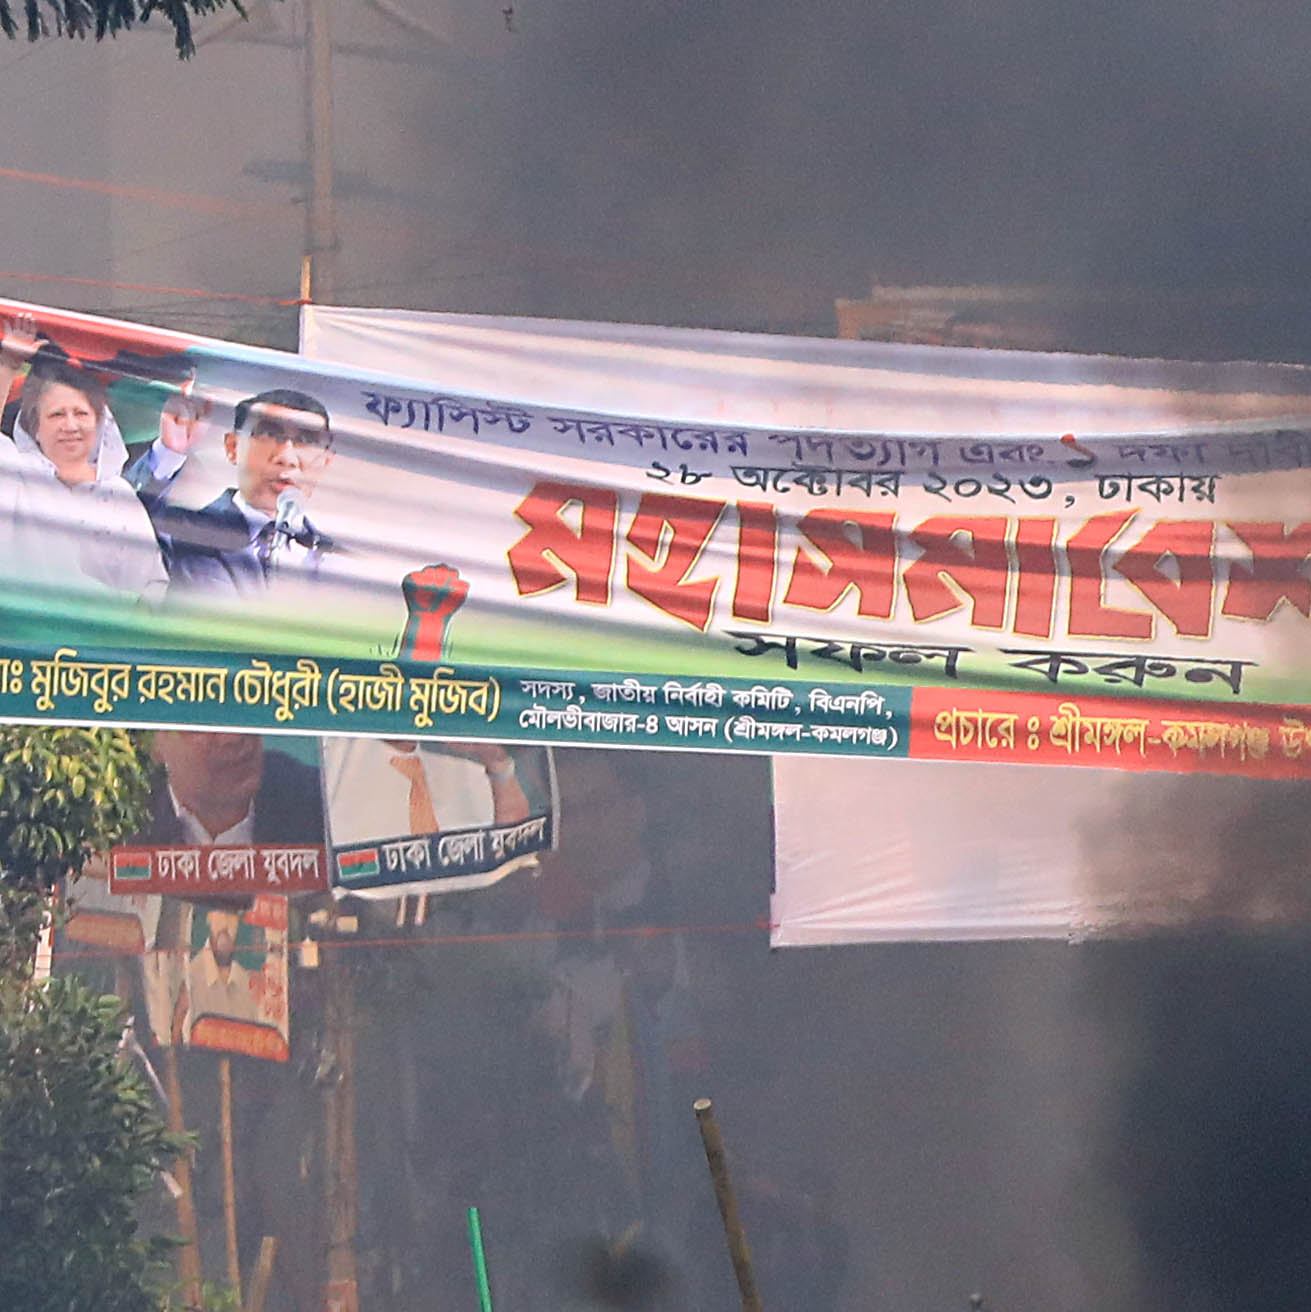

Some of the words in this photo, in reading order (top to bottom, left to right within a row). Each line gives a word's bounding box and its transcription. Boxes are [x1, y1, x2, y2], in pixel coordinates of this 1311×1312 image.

[362, 391, 533, 436] ফ্যাসিস্ট
[547, 416, 750, 457] সরকারের
[769, 433, 940, 469] পদত্যাগ
[646, 460, 711, 487] ২৮
[731, 463, 903, 499] অক্টোবর
[1097, 472, 1222, 504] ঢাকায়
[721, 630, 977, 680] সফল
[998, 647, 1259, 695] করুন
[30, 648, 131, 712] মুজিবুর
[136, 664, 228, 706] রহমান
[232, 658, 322, 720] চৌধুরী
[326, 663, 405, 716] (হাজী
[408, 667, 500, 729] মুজিব)
[592, 681, 656, 705] জাতীয়
[663, 680, 726, 708] নির্বাহী
[665, 715, 719, 738] আসন
[157, 849, 200, 880] ঢাকা
[207, 848, 257, 880] জেলা
[261, 848, 320, 884] যুবদল
[384, 838, 431, 872] ঢাকা
[437, 831, 485, 868] জেলা
